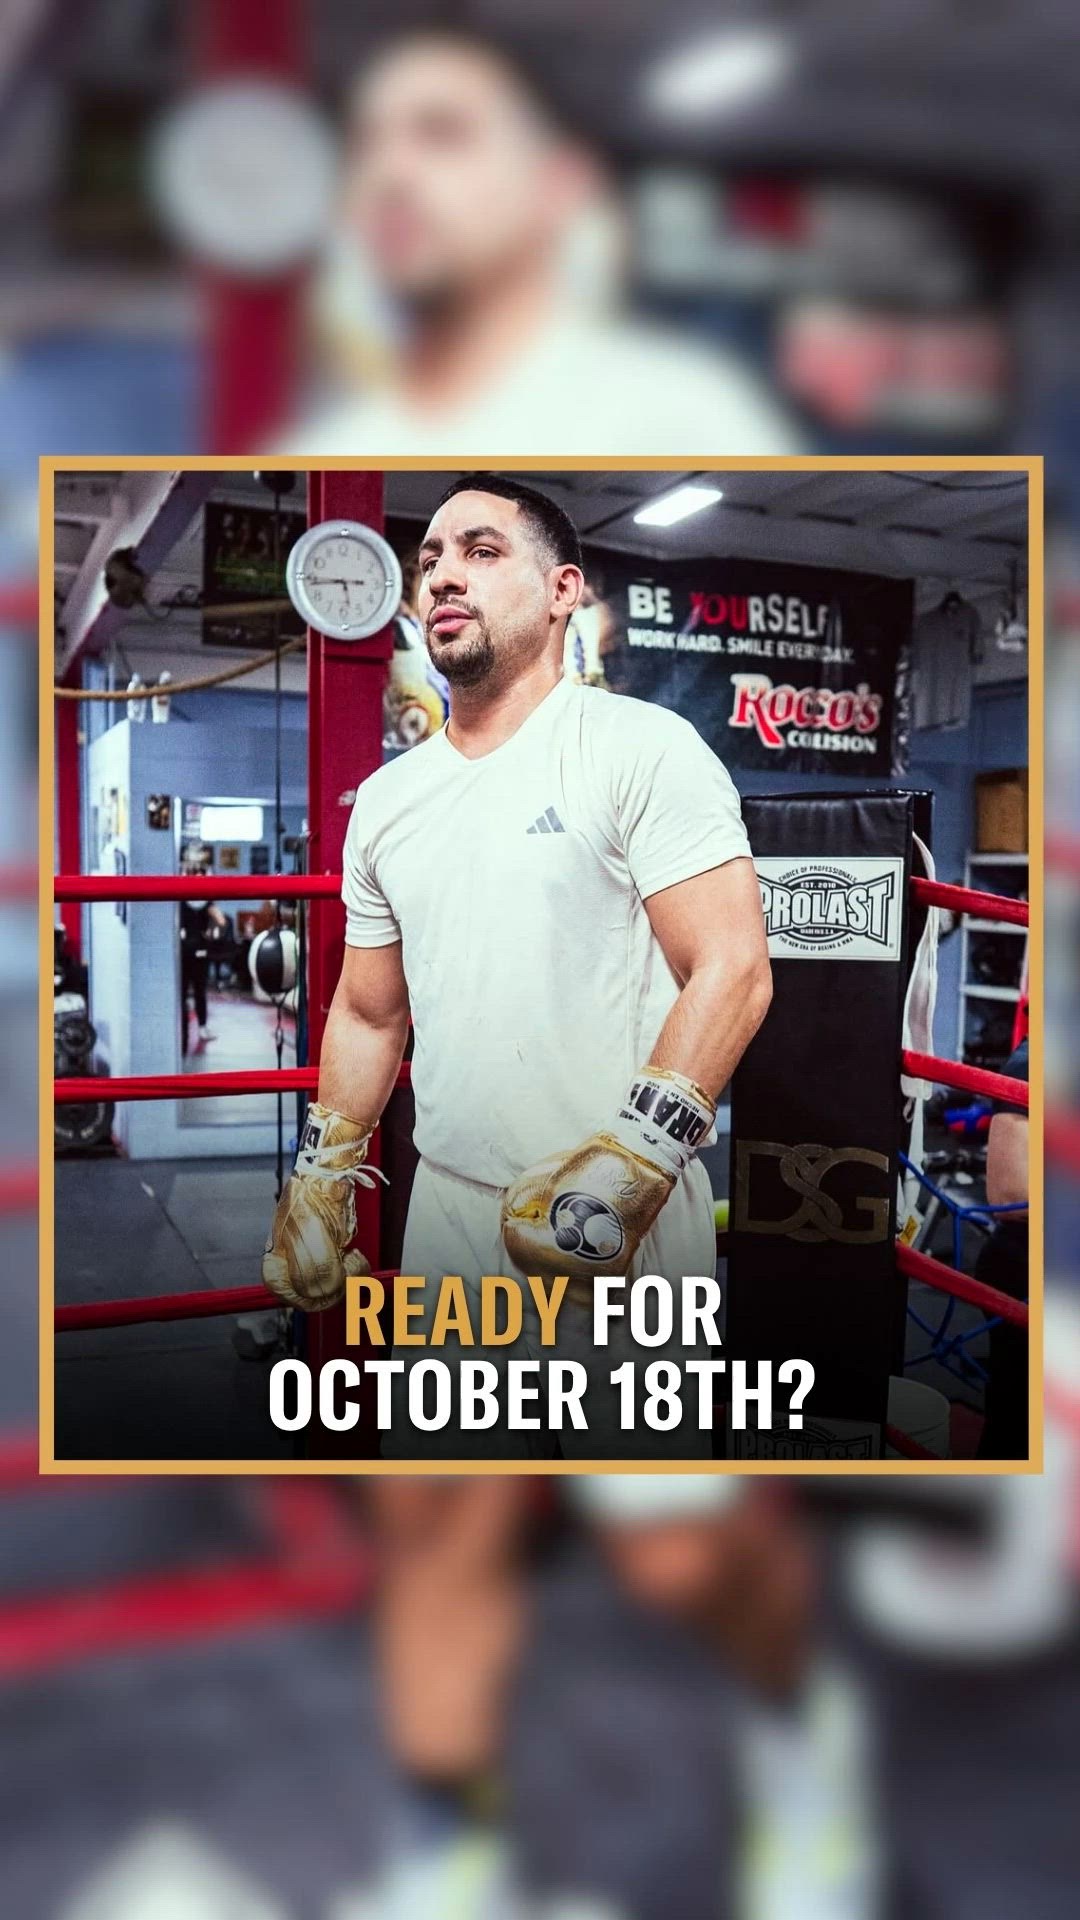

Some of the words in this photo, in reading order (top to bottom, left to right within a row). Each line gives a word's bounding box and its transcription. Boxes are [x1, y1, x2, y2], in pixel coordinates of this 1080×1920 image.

[628, 584, 674, 625] BE
[627, 628, 676, 648] WORK
[727, 636, 775, 657] SMILE
[778, 869, 799, 882] CHOICE
[734, 1139, 890, 1244] DSG
